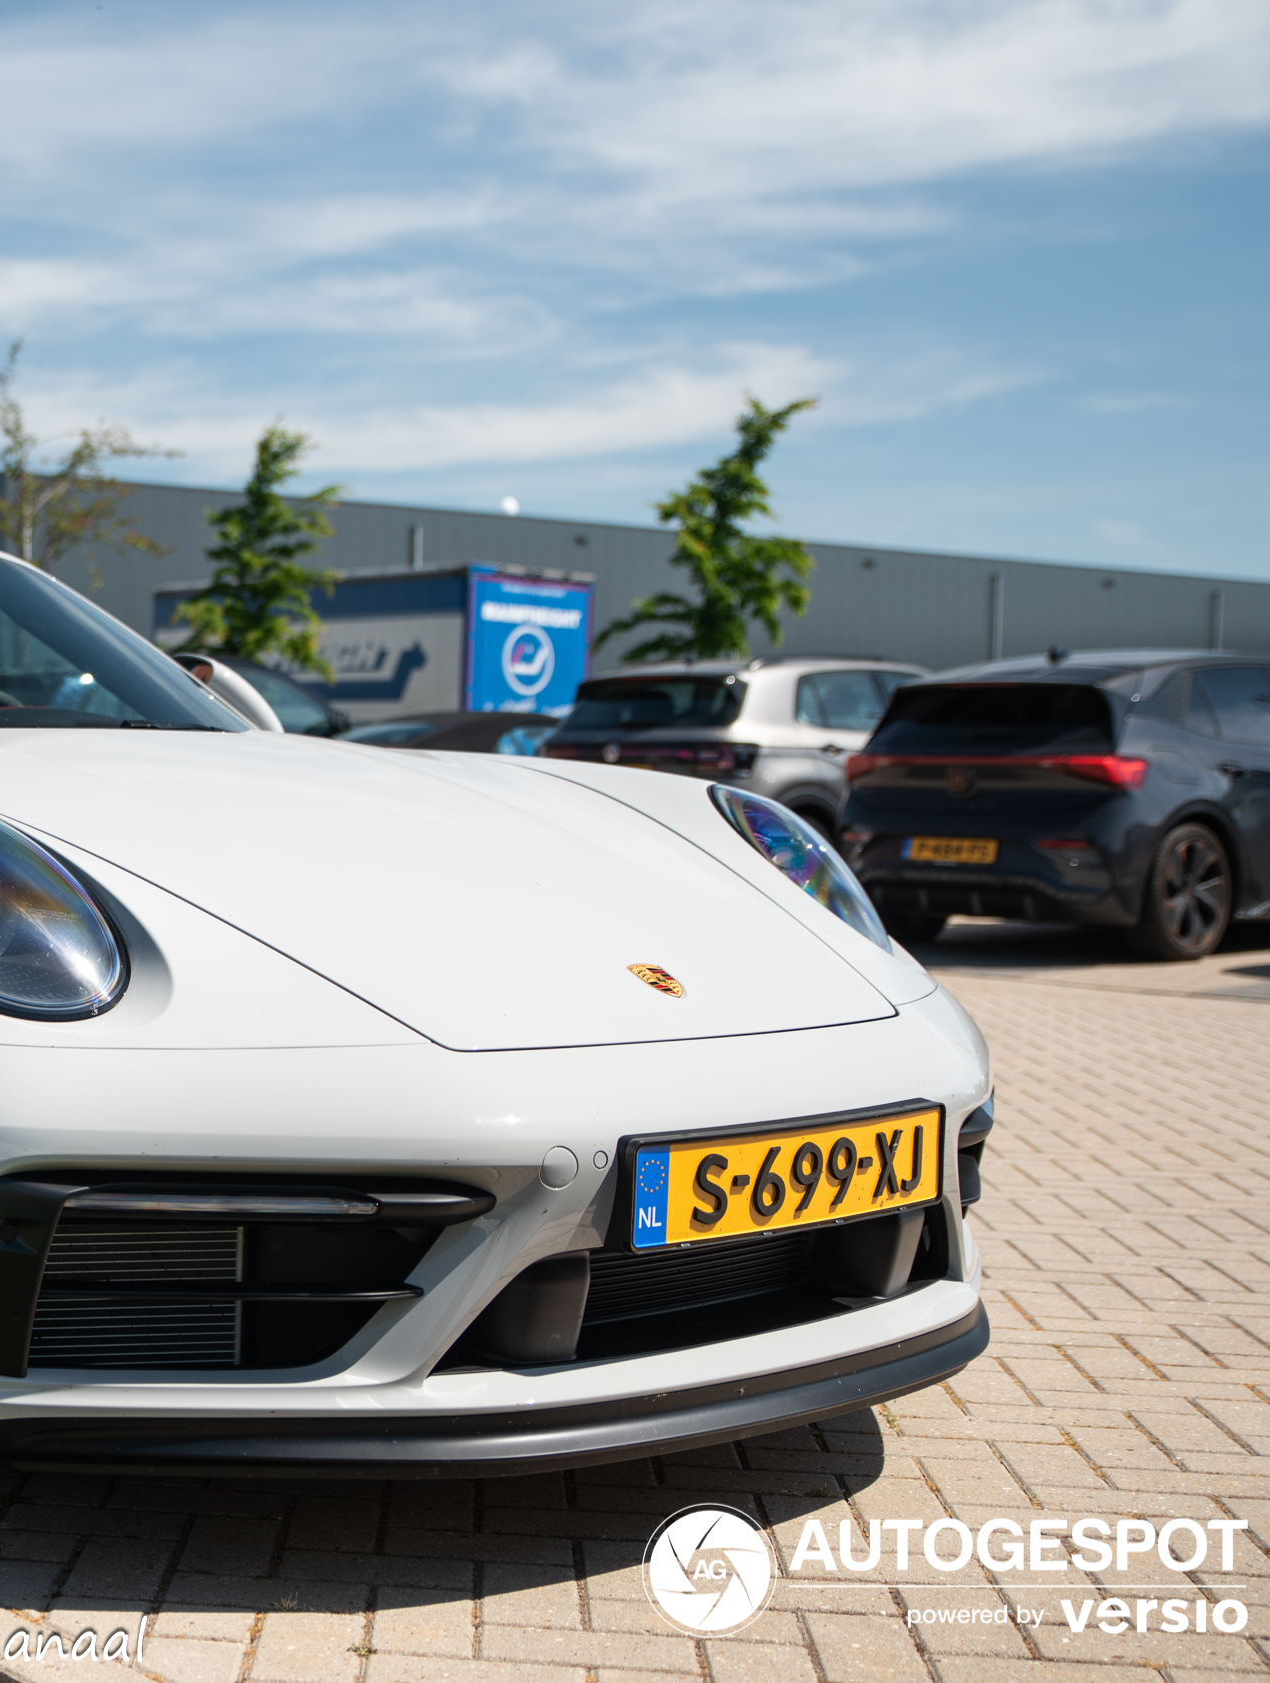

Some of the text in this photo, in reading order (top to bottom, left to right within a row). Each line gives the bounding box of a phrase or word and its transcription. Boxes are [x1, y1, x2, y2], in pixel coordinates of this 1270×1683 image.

[28, 907, 79, 920] PORSCHE
[692, 1124, 924, 1225] S-699-XJ
[637, 1205, 662, 1230] NL
